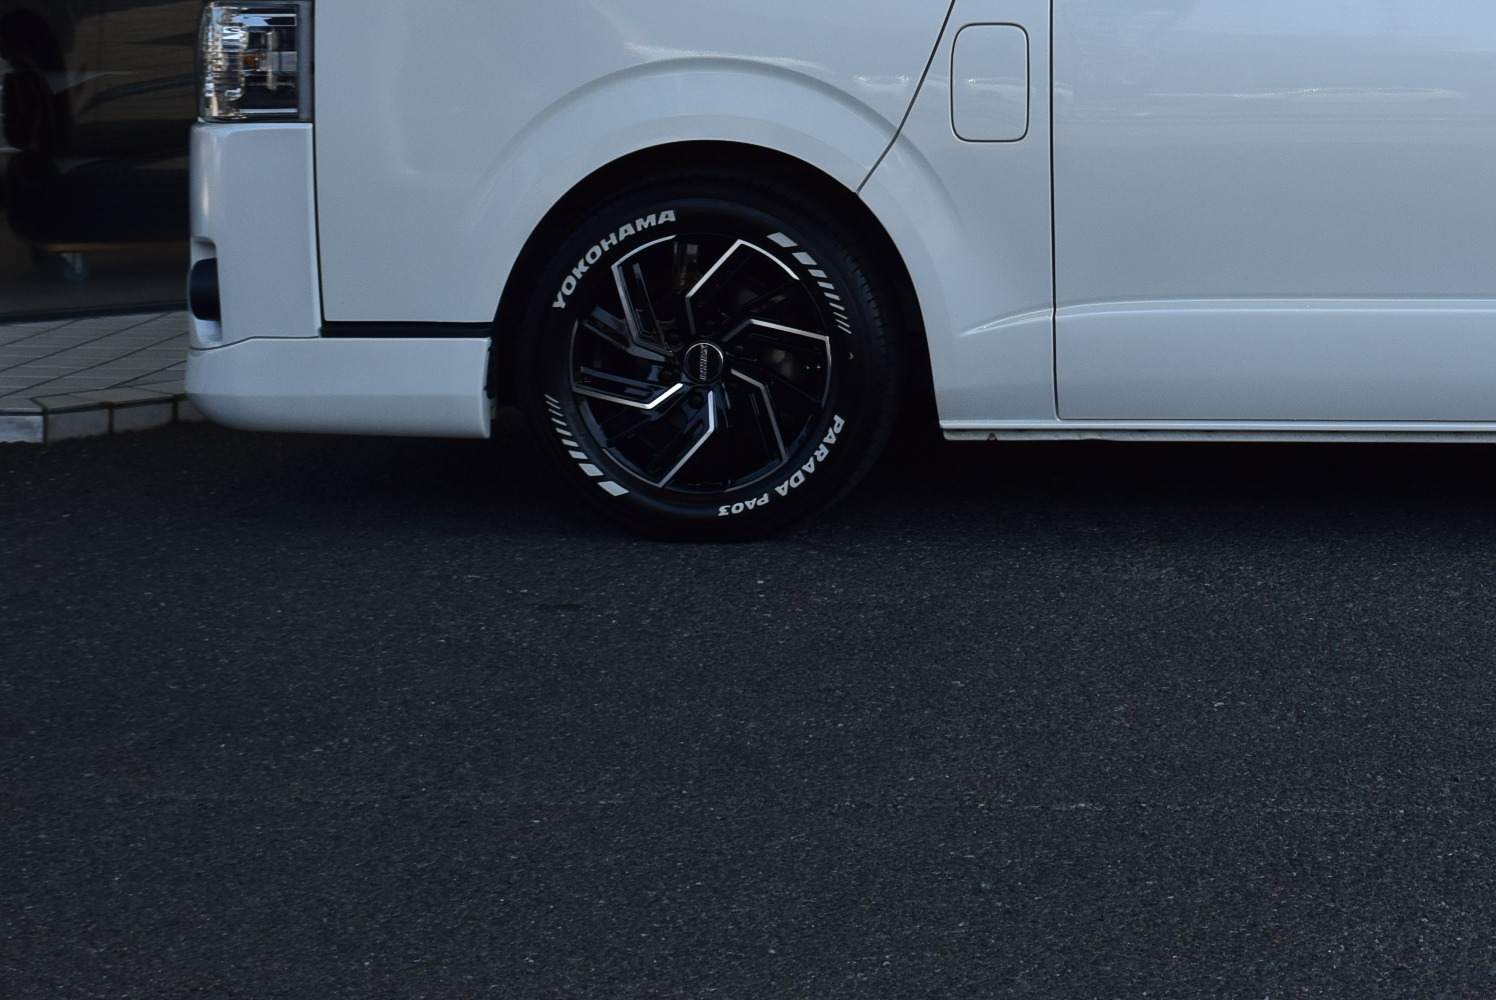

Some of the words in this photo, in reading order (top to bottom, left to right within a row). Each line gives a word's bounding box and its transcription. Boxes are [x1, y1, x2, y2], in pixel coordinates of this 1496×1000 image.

[552, 209, 677, 310] YOKOHAMA
[774, 413, 845, 498] PARADA
[717, 492, 770, 518] PA03
